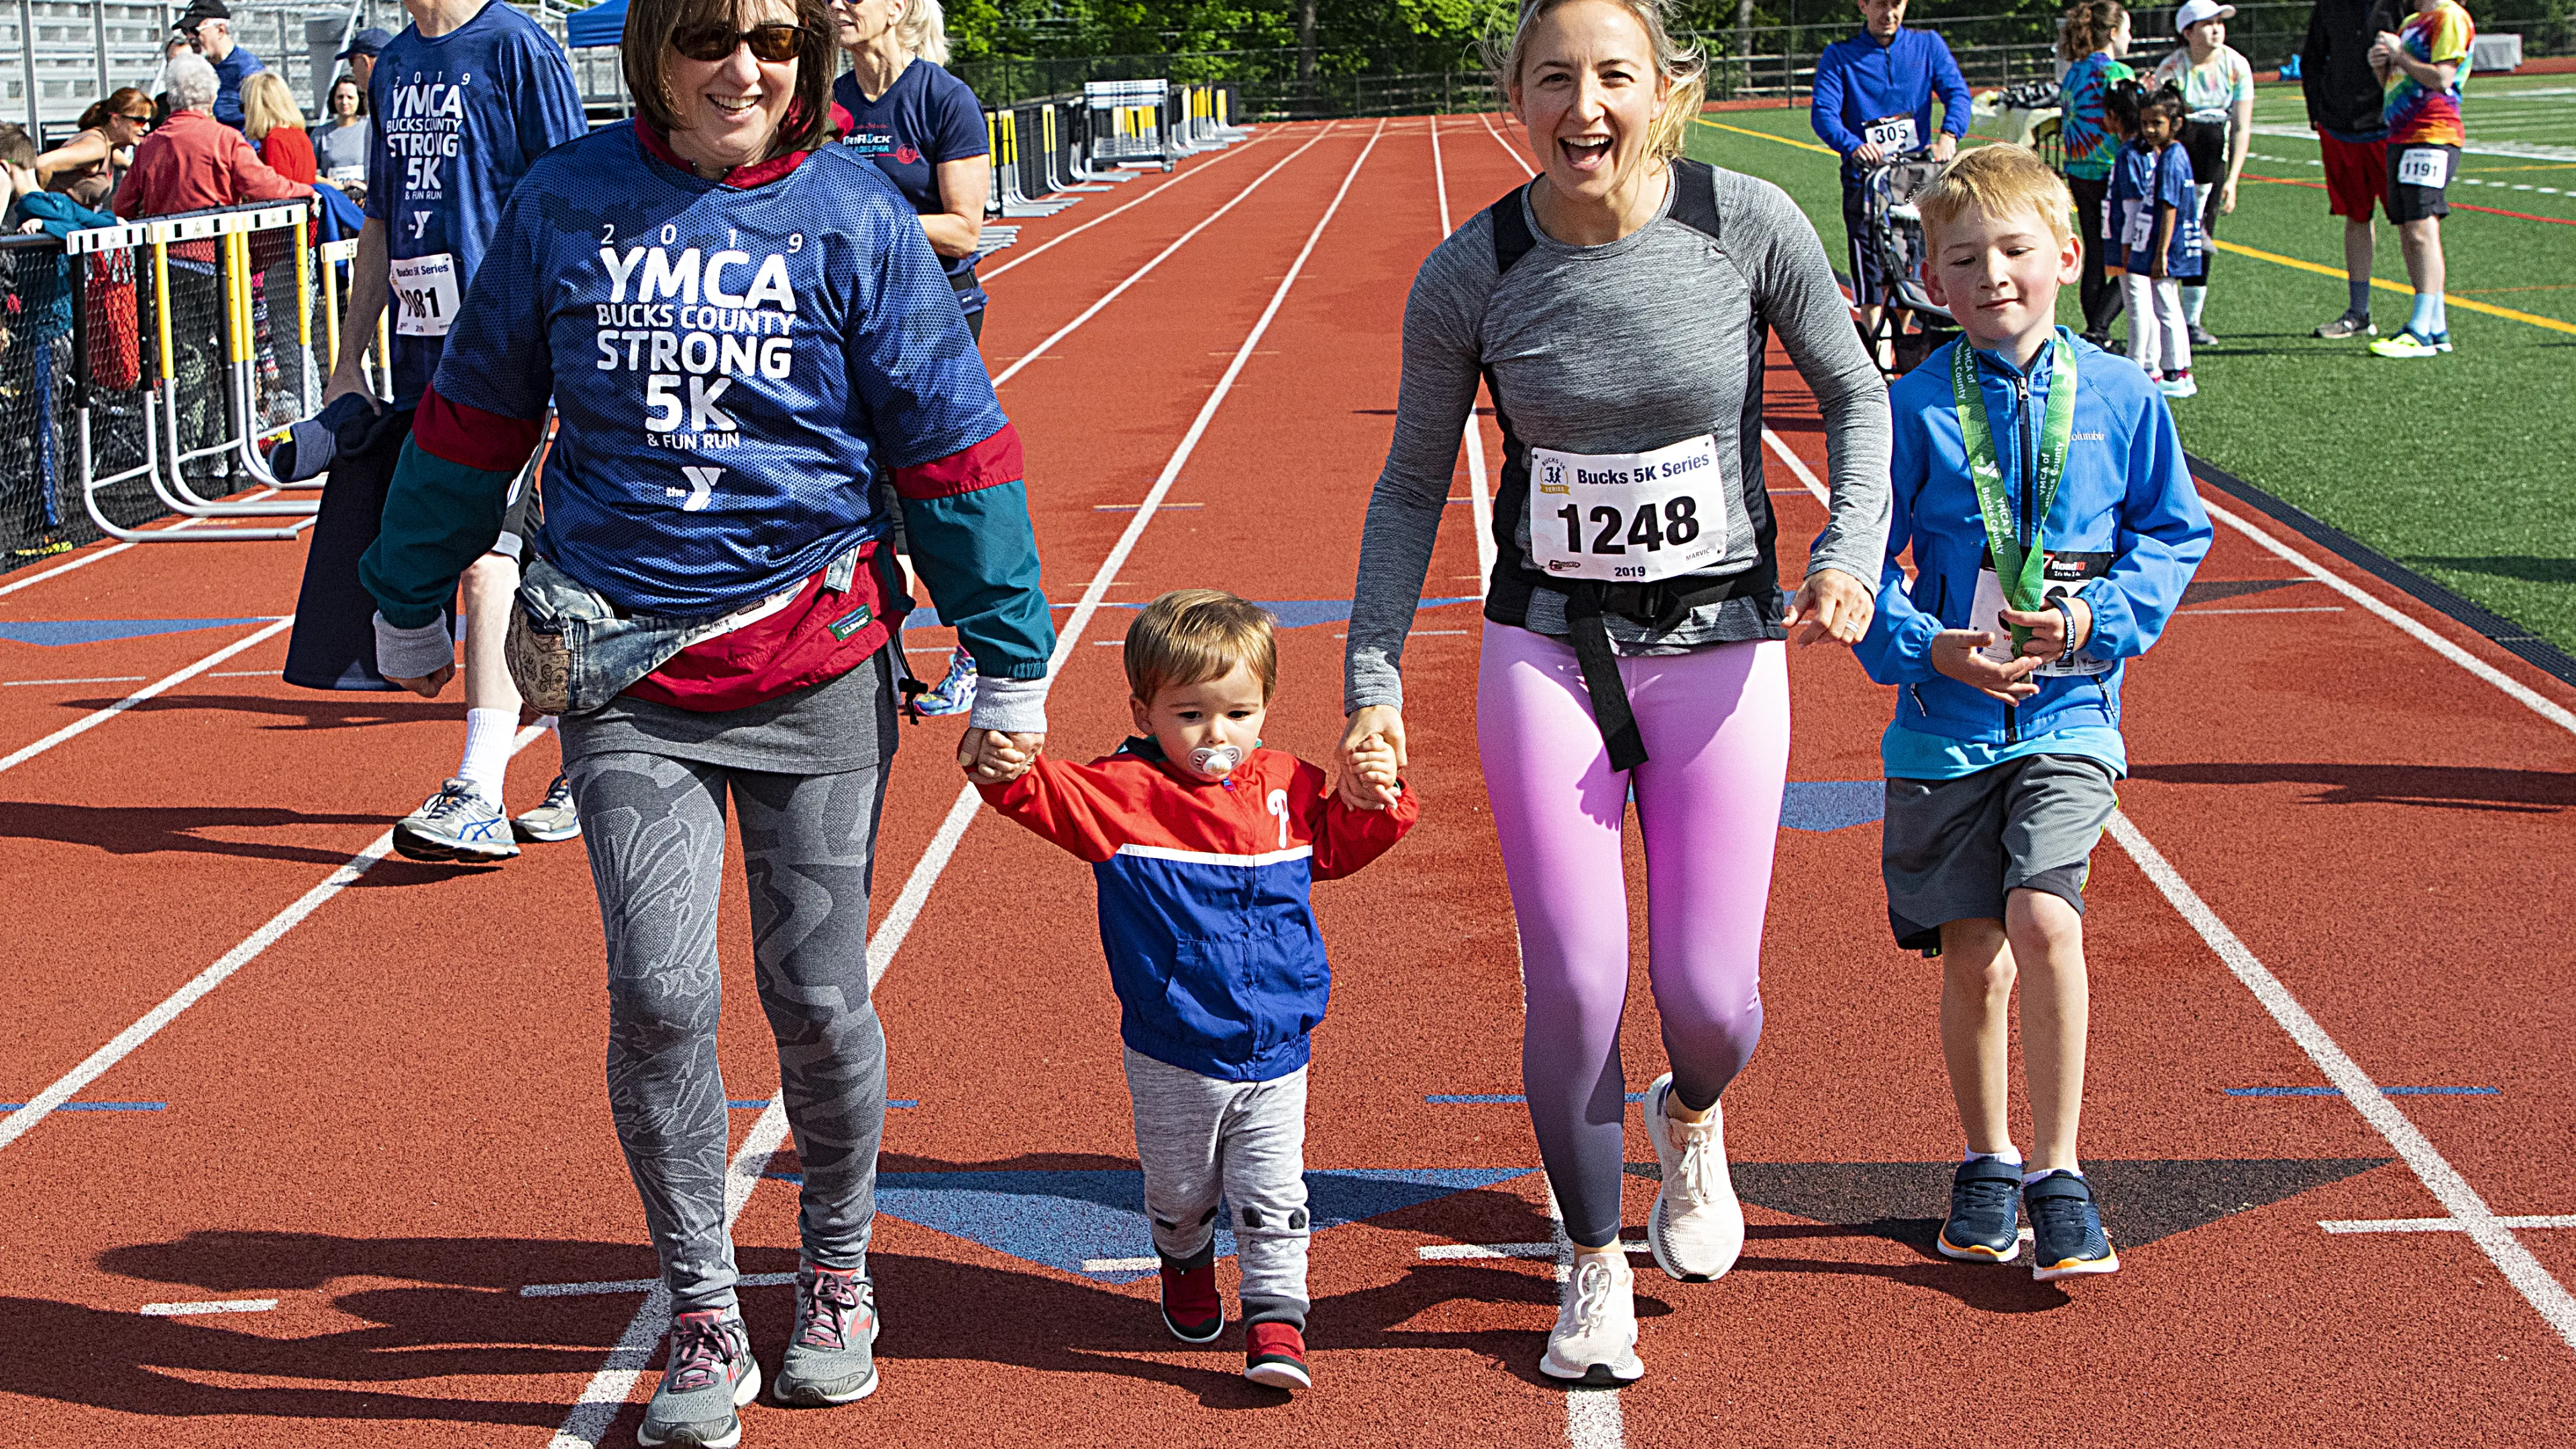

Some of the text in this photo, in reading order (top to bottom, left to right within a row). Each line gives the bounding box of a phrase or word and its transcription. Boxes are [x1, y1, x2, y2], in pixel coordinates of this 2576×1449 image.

[392, 84, 463, 119] YMCA
[386, 118, 462, 133] BUCKS COUNTY
[1875, 123, 1908, 144] 305
[387, 133, 459, 158] STRONG
[406, 157, 442, 190] 5K
[2405, 162, 2437, 177] 1191
[405, 191, 442, 200] & FUN RUN
[421, 264, 449, 275] Series
[598, 246, 797, 312] YMCA
[400, 286, 440, 319] 1081
[596, 304, 797, 335] BUCKS COUNTY
[596, 330, 793, 379] STRONG
[1964, 345, 1976, 384] YMCA of
[1955, 366, 1966, 399] County
[645, 374, 737, 432] 5K
[647, 432, 740, 449] & FUN RUN
[2069, 431, 2104, 441] olumbia
[1542, 458, 1558, 466] BUCKS
[1577, 453, 1709, 484] Bucks 5K Series
[2039, 452, 2050, 496] YMCA of
[2050, 441, 2065, 476] County
[682, 466, 722, 511] Y
[1557, 496, 1699, 555] 1248
[1982, 486, 2004, 554] Bucks County
[1996, 496, 2014, 539] YMCA of
[1686, 547, 1710, 561] MARVIC
[1615, 566, 1646, 577] 2019
[2065, 616, 2074, 648] STRONG
